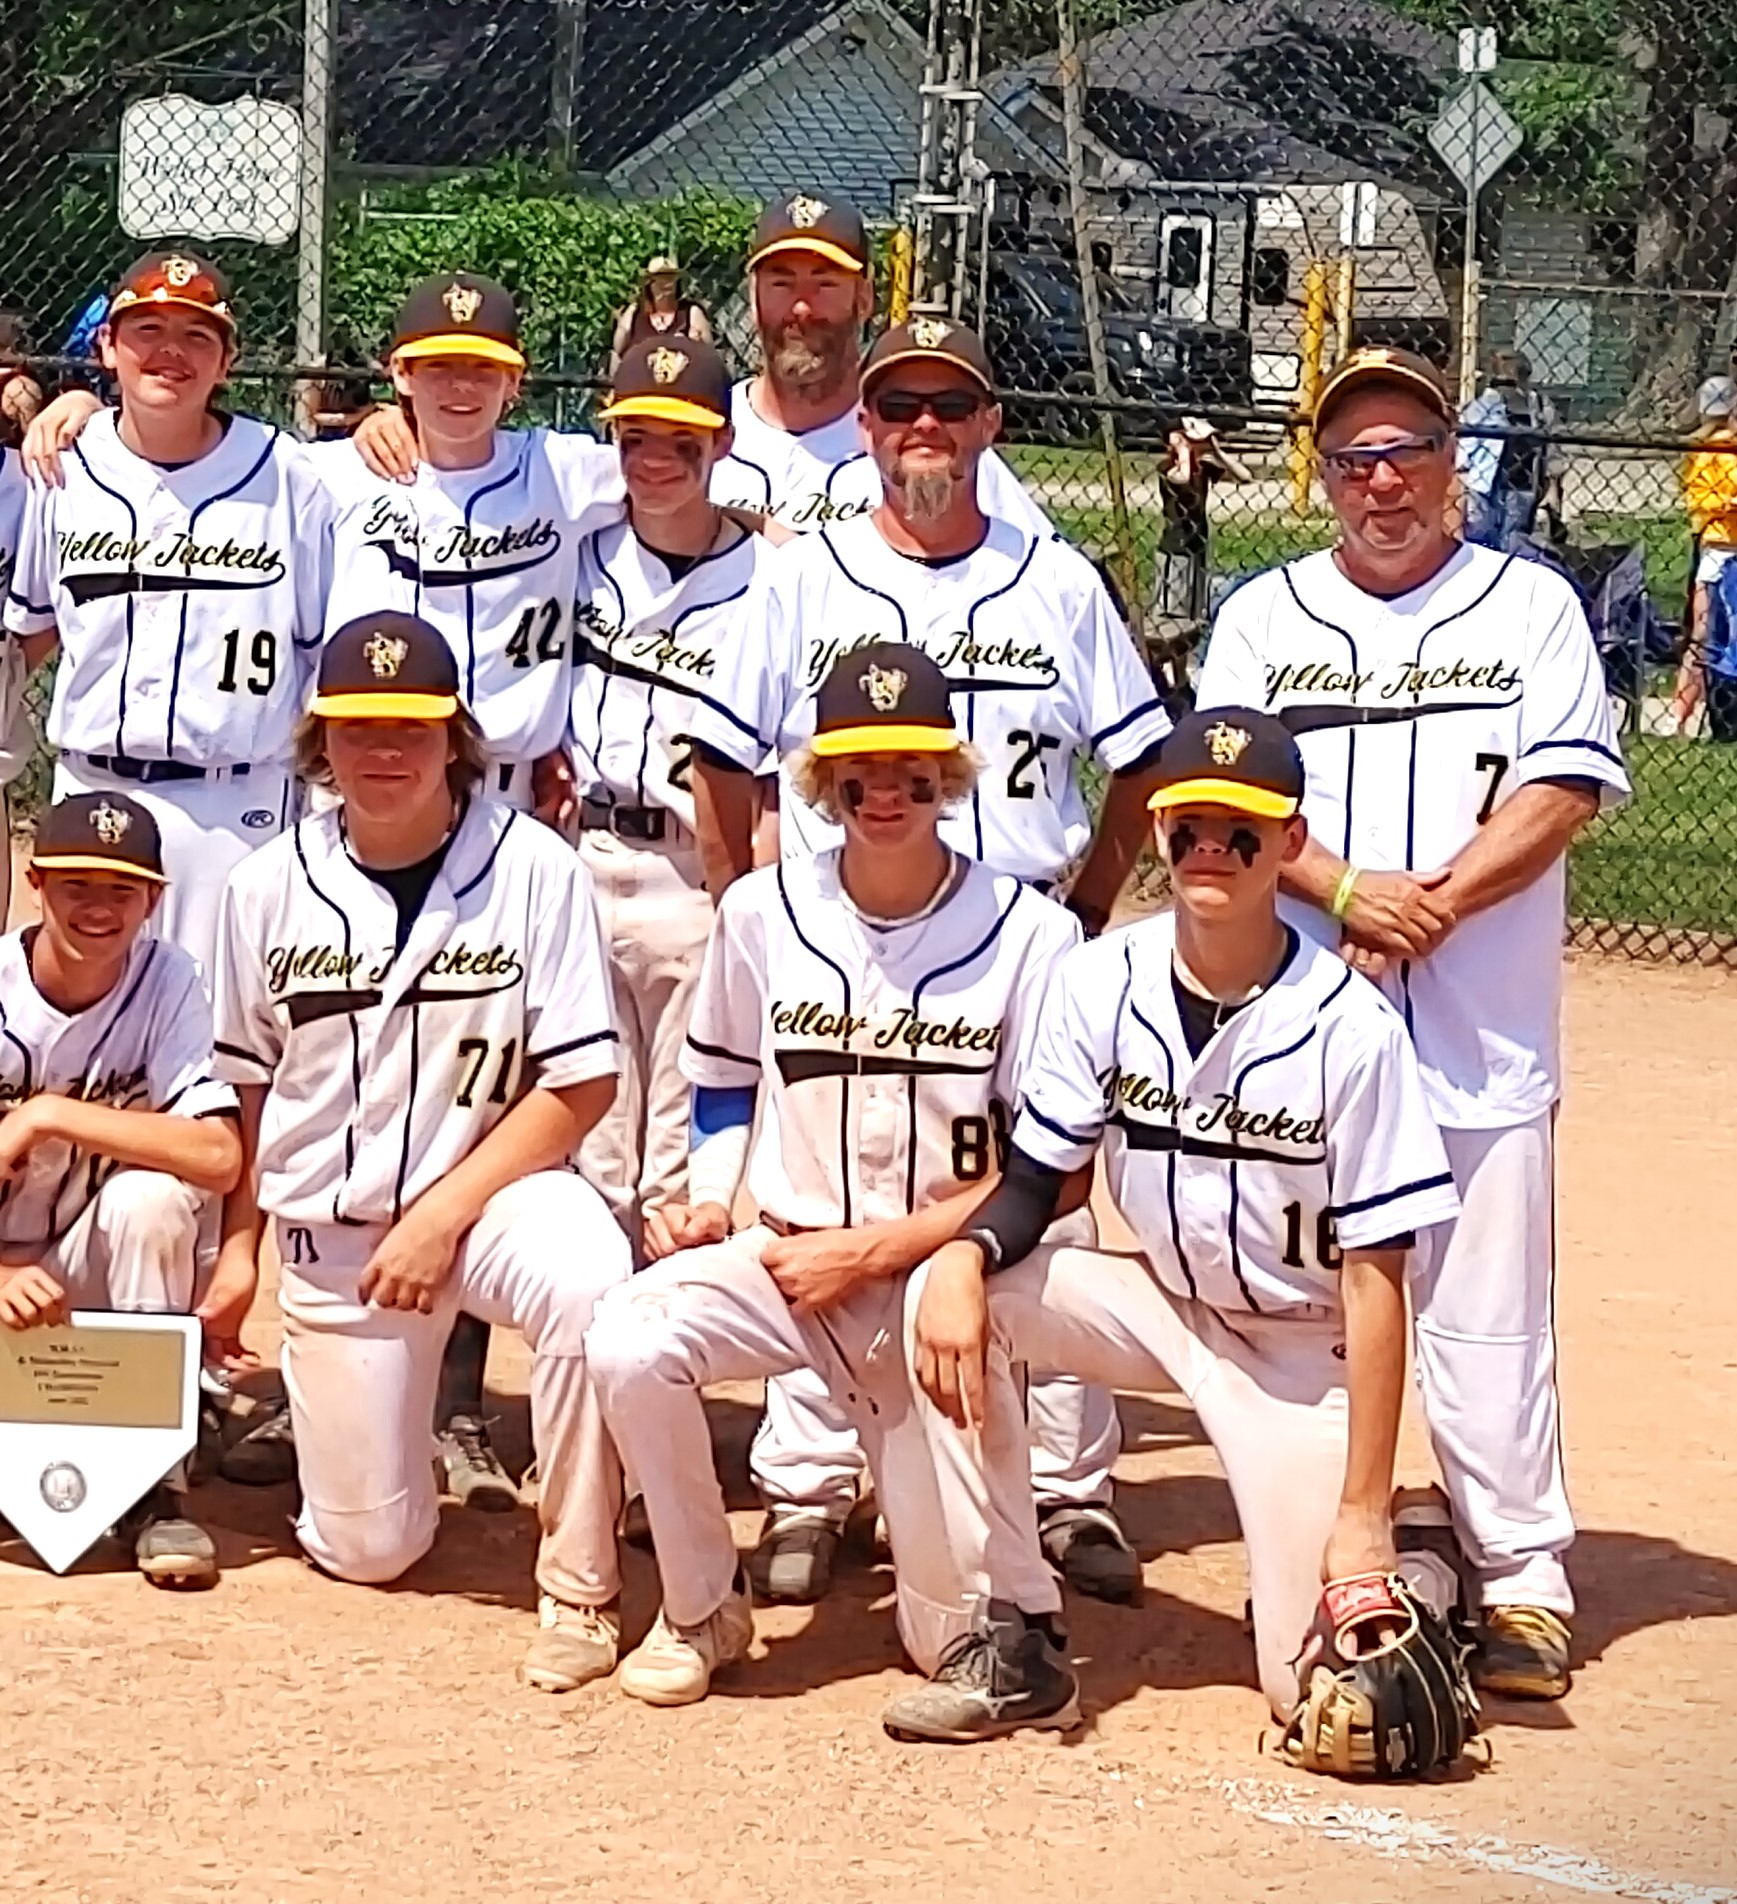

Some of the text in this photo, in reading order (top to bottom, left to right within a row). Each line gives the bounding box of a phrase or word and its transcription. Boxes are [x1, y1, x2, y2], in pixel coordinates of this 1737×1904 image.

[154, 533, 282, 571] Jackets
[434, 518, 555, 563] Jackets
[217, 627, 276, 696] 19
[505, 597, 564, 678] 42
[1381, 657, 1520, 699] Jackets
[1475, 752, 1509, 825] 7
[267, 945, 362, 993] Yellow
[771, 1001, 1002, 1052] ellow Jacket
[456, 1036, 517, 1107] 71
[1196, 1093, 1328, 1144] Jacket
[287, 1227, 320, 1264] 71
